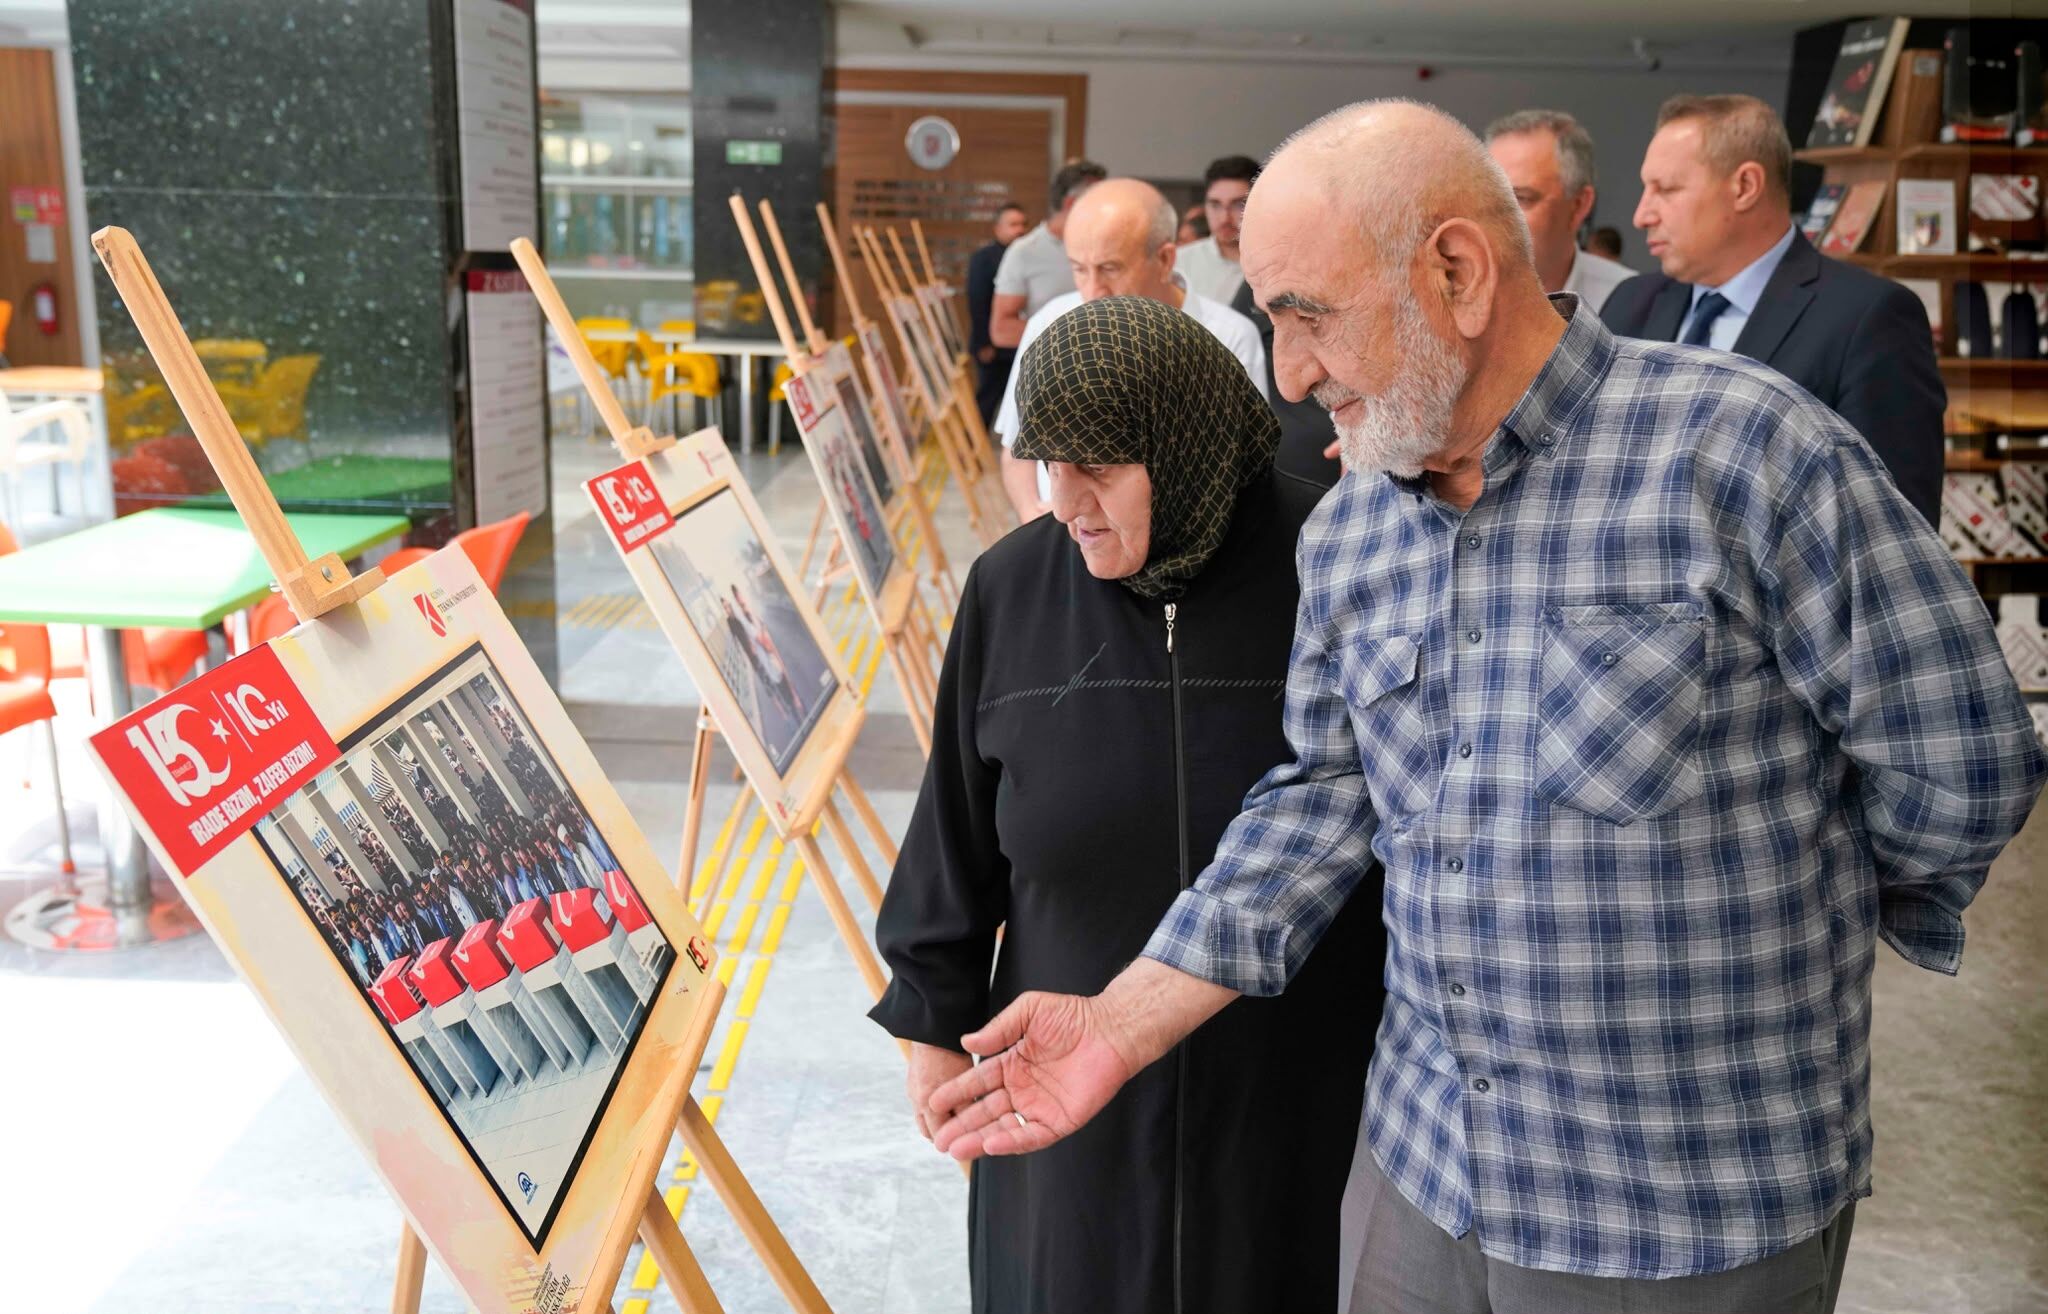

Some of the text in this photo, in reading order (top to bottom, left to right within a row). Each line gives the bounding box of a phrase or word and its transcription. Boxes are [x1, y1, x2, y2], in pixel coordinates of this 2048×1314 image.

[125, 703, 214, 807] 15
[188, 807, 229, 847] İRADE
[253, 761, 289, 798] ZAFER
[281, 740, 317, 779] BİZİM!
